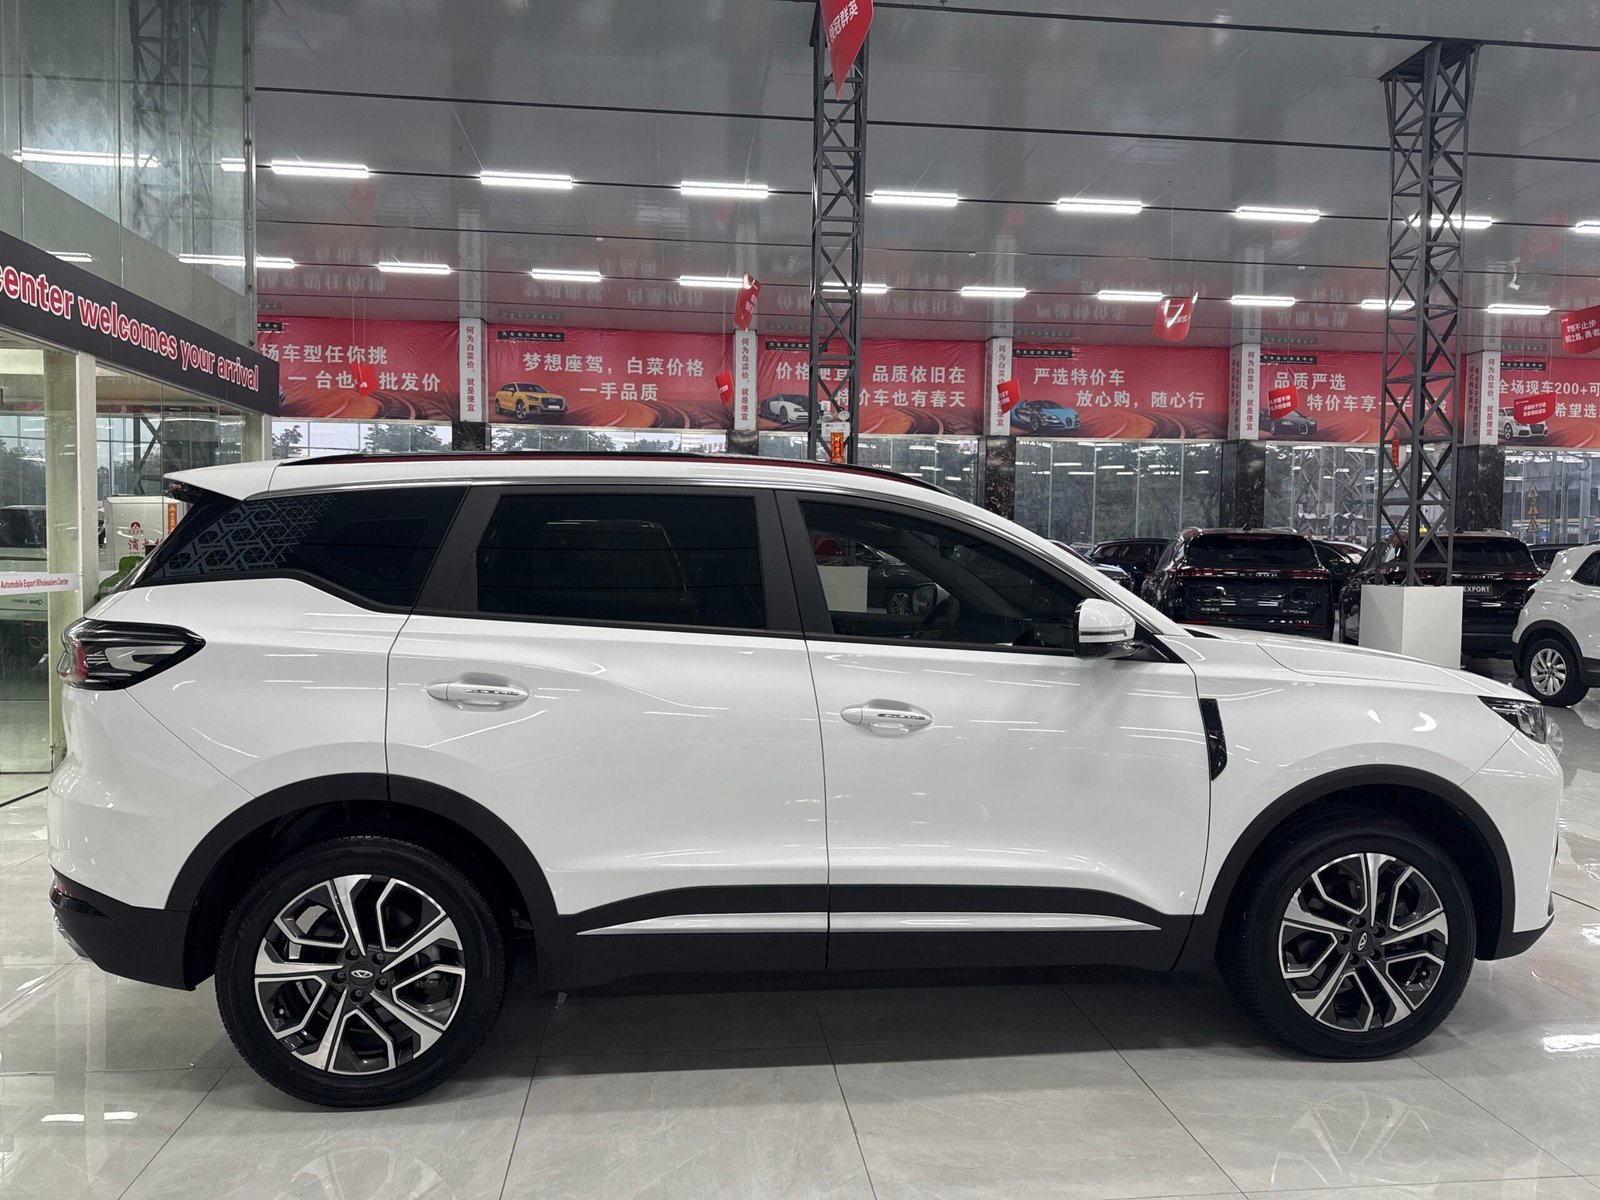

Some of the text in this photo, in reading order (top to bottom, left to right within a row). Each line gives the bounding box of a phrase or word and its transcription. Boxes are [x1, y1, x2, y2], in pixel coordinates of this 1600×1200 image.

[78, 295, 177, 360] welcomes
[180, 339, 215, 371] your
[217, 356, 259, 391] arrival
[260, 343, 388, 365] 场车型任你挑
[522, 352, 705, 378] 梦想座驾，白菜价格
[287, 369, 441, 393] 一台也批发价
[1033, 367, 1125, 387] 严选特价车
[1274, 371, 1346, 391] 品质严选
[578, 382, 658, 402] 一手品质
[1076, 390, 1205, 409] 放心购，随心行
[1555, 402, 1600, 419] 希望选
[0, 580, 23, 588] Automobile
